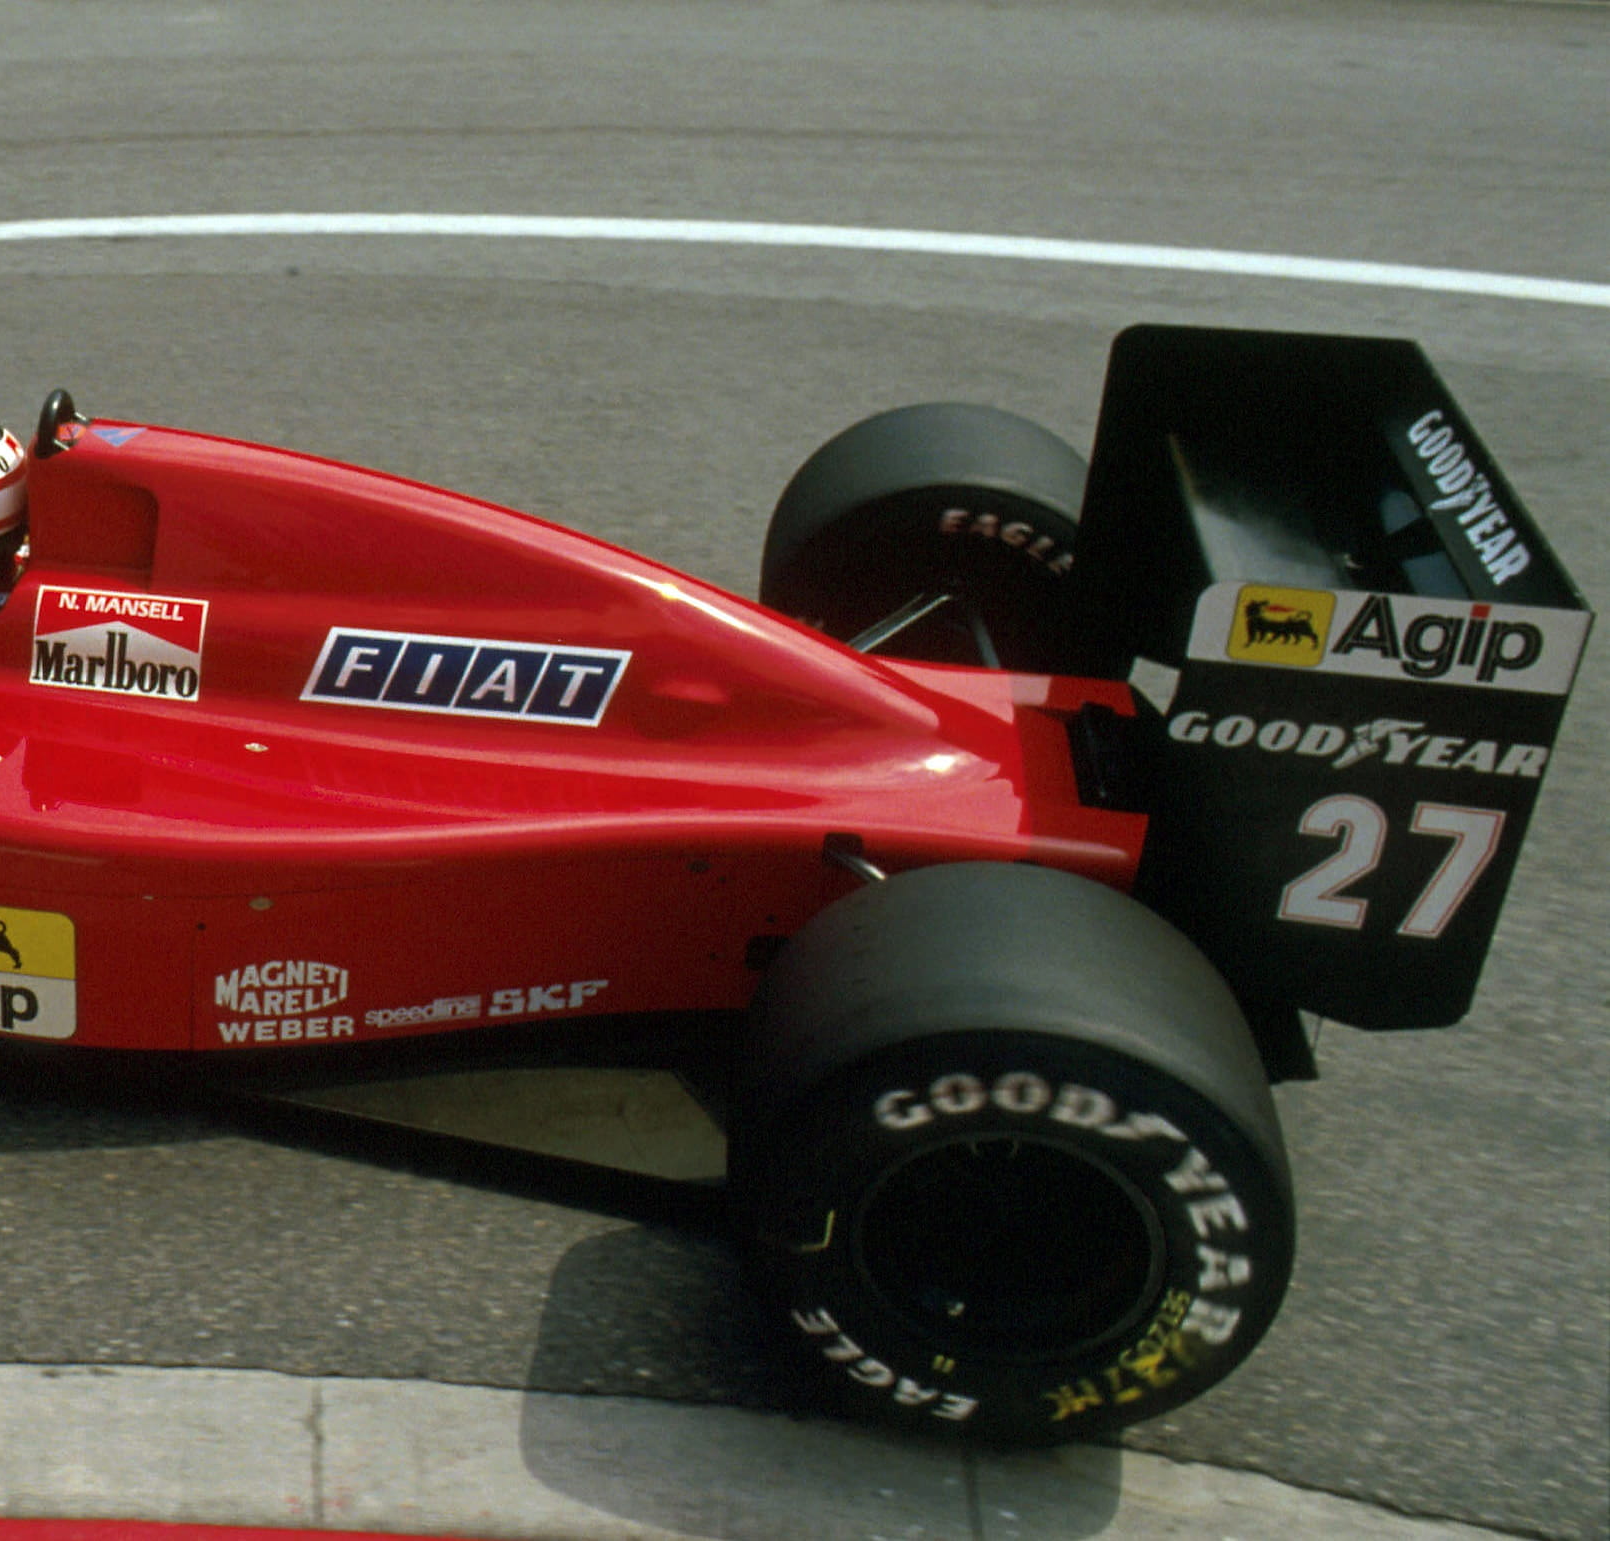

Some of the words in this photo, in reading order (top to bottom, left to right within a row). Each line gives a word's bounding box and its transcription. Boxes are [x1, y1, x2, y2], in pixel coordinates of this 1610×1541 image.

[1407, 409, 1531, 586] GOODYEAR
[59, 593, 80, 611] N.
[85, 595, 184, 622] MANSELL
[1332, 595, 1544, 683] Agip
[34, 631, 198, 698] Marlboro
[334, 646, 604, 708] FIAT
[1277, 794, 1507, 939] 27
[215, 960, 349, 998] MAGNETI
[215, 978, 349, 1016] MARELLI
[488, 979, 609, 1017] SKF
[218, 1016, 354, 1043] WEBER
[365, 995, 481, 1028] speedline
[792, 1307, 980, 1421] EAGLE
